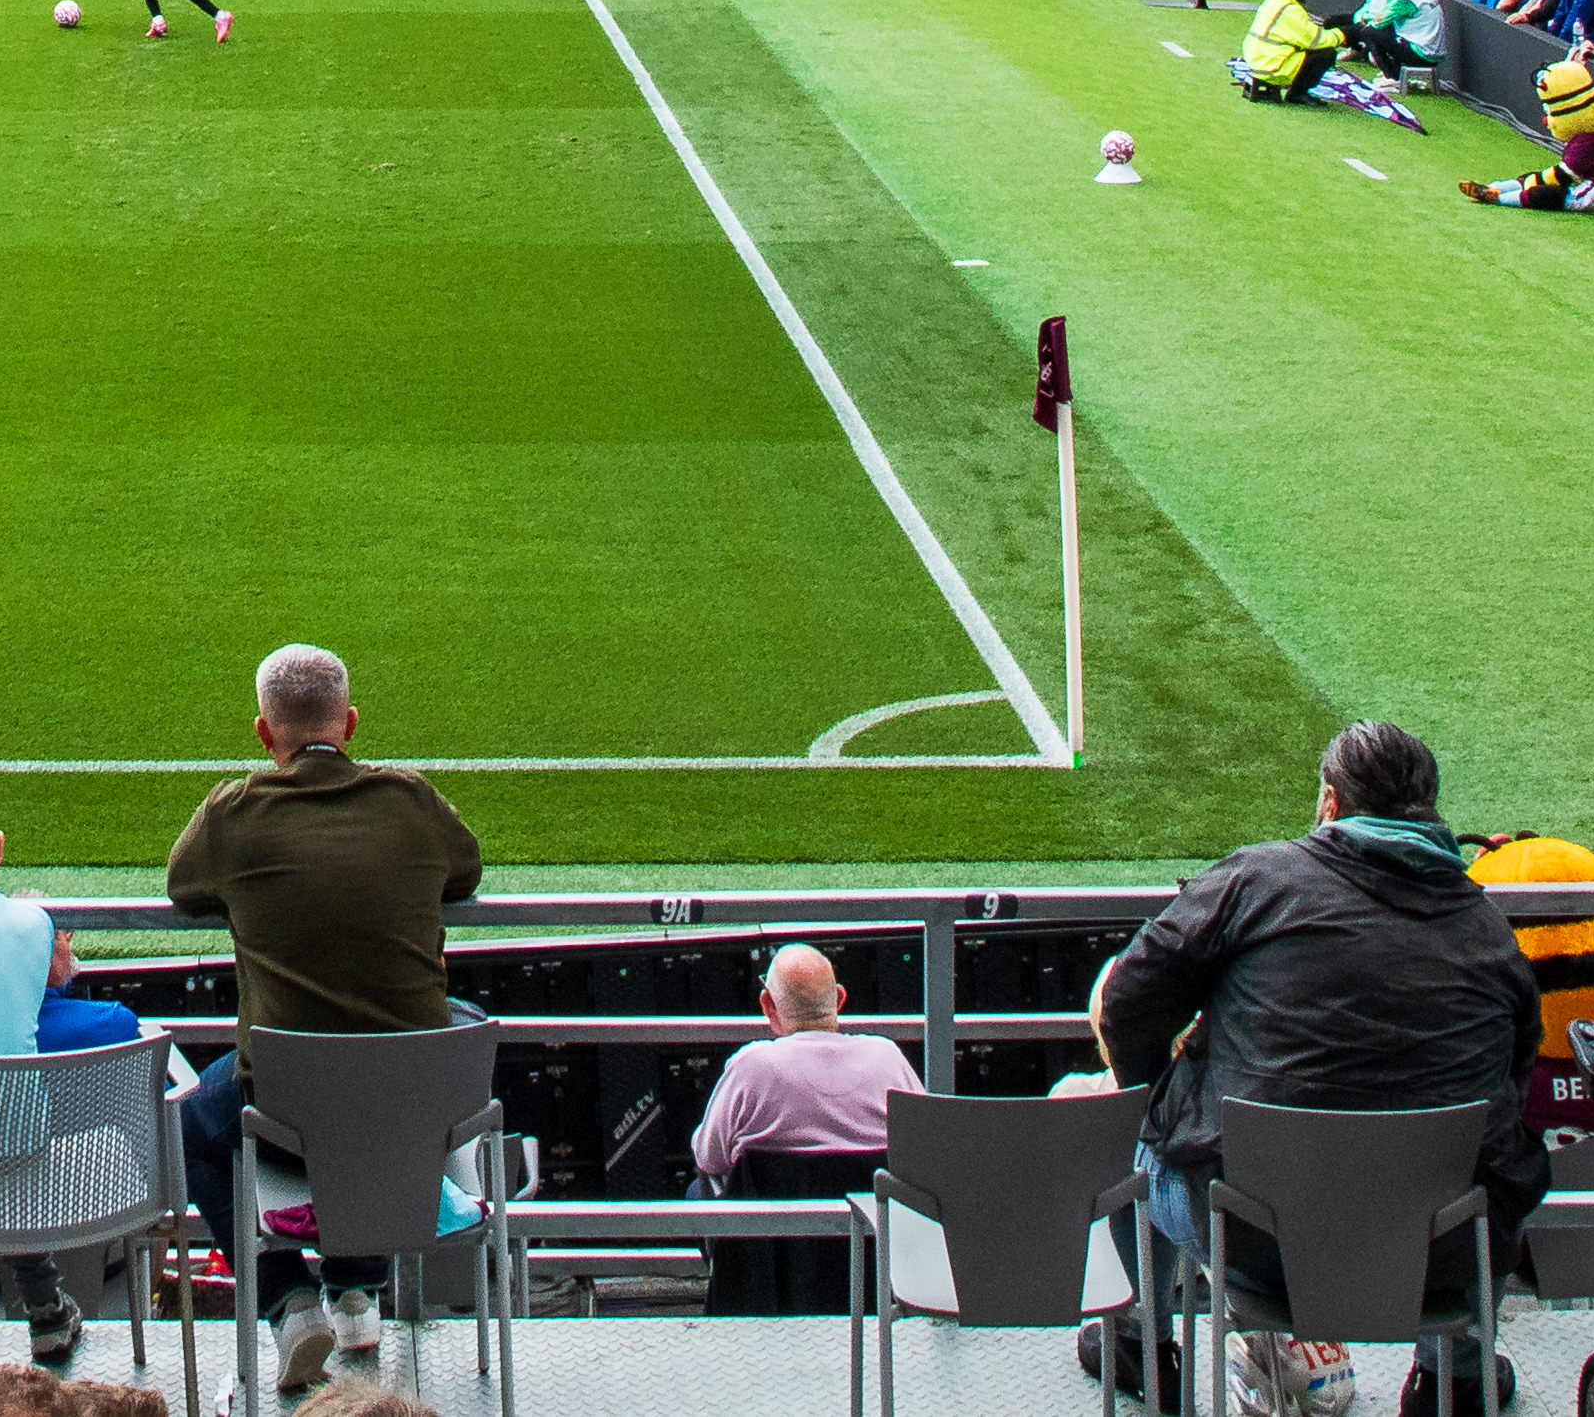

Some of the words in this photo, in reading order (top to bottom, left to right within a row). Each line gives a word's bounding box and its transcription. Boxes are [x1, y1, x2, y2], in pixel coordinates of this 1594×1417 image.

[661, 898, 692, 924] 9A
[983, 892, 1000, 920] 9
[1552, 1077, 1585, 1103] BE
[612, 1088, 657, 1141] adi.tv
